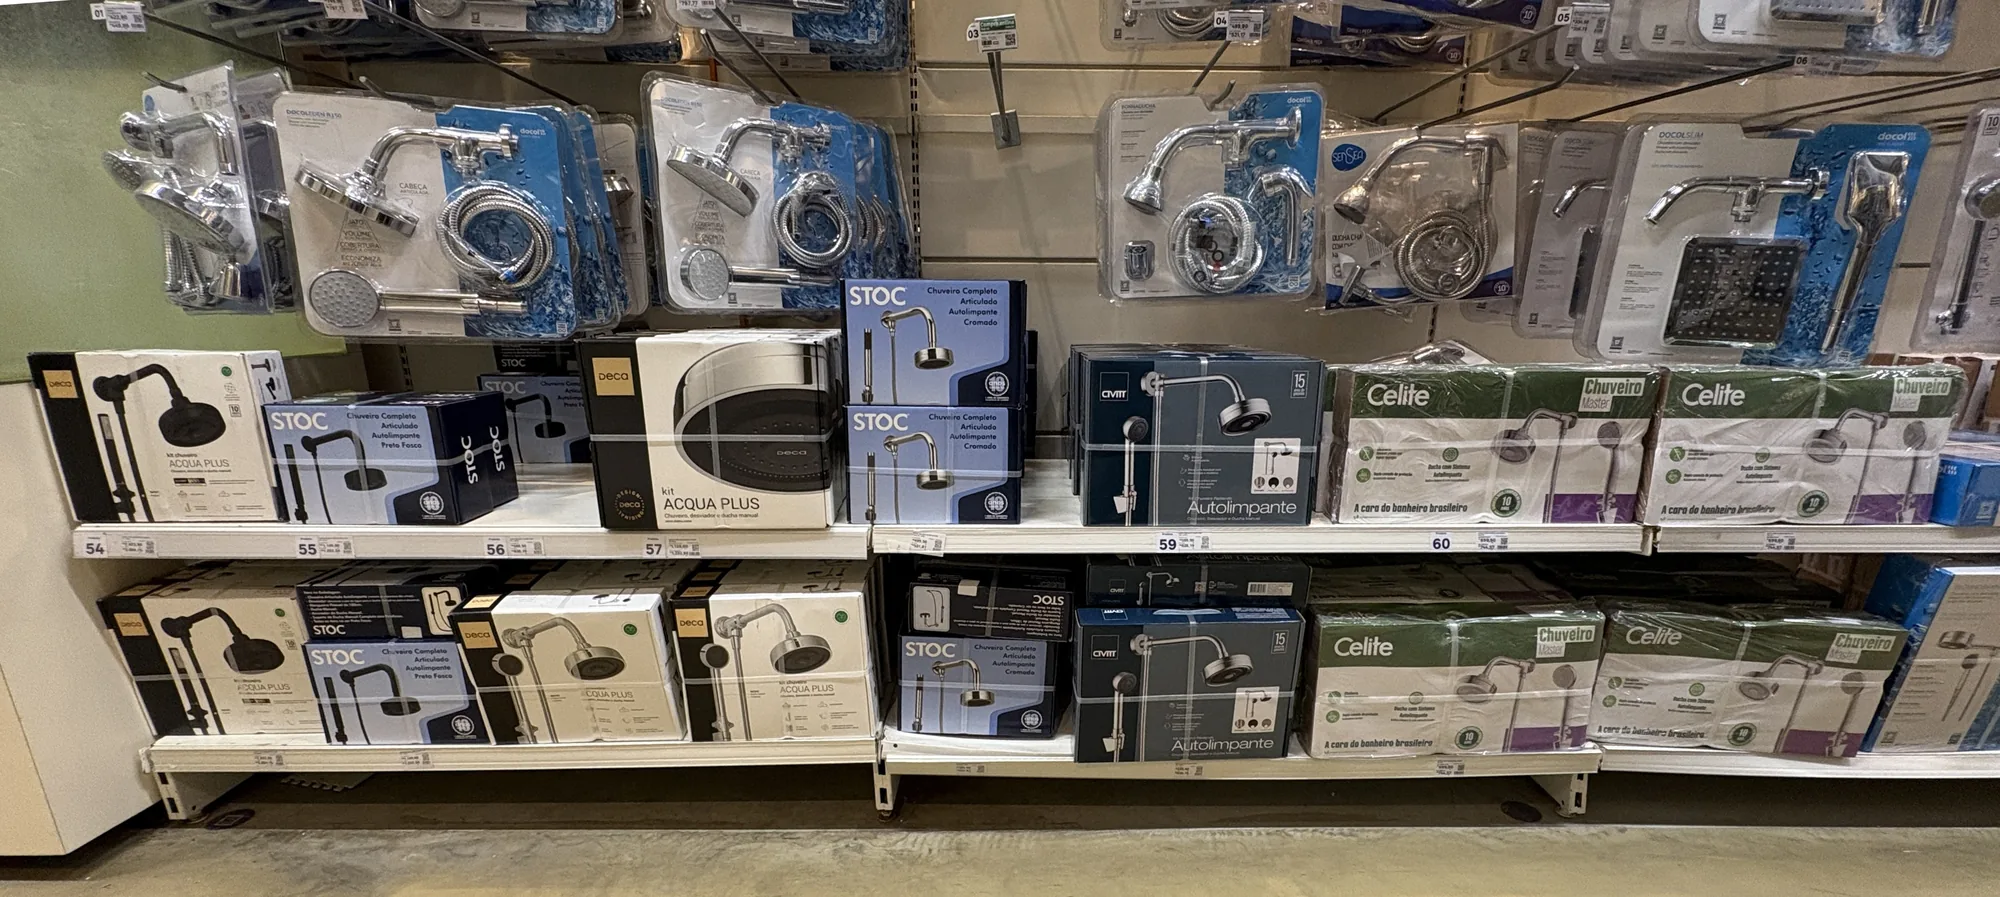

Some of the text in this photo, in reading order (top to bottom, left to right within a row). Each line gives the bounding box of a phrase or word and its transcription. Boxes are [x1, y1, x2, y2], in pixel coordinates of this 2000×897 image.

[94, 9, 104, 18] 01
[1557, 13, 1570, 22] 05
[1216, 17, 1227, 25] 04
[968, 29, 979, 39] 03
[1796, 56, 1808, 65] 06
[1287, 96, 1306, 104] docol
[1987, 116, 1999, 127] 10
[520, 128, 540, 136] docol
[1877, 132, 1908, 141] docol
[849, 286, 906, 306] STOC
[927, 287, 998, 296] Chuveiro Completo
[949, 308, 998, 316] Autolimpante
[501, 358, 526, 368] STOC
[598, 371, 629, 381] Deca
[1294, 374, 1306, 388] 15
[484, 381, 526, 394] STOC
[1584, 378, 1643, 395] Chuveiro
[1895, 378, 1950, 394] Chuveiro
[1367, 383, 1430, 407] Celite
[1682, 383, 1746, 407] Celite
[1581, 397, 1610, 409] Master
[271, 411, 328, 431] STOC
[346, 412, 417, 421] Chuveiro Completo
[853, 412, 909, 431] STOC
[928, 413, 997, 422] Chuveiro Completo
[371, 432, 421, 440] Autolimpante
[950, 433, 997, 441] Autolimpante
[381, 441, 422, 449] Preto Fosco
[489, 425, 506, 473] STOC
[169, 459, 230, 469] ACQUA PLUS
[460, 435, 479, 485] STOC
[661, 487, 674, 496] kit
[663, 497, 760, 511] ACQUA PLUS
[1502, 497, 1512, 506] 10
[1809, 497, 1820, 507] 10
[1186, 500, 1297, 516] Autolimpante
[1354, 504, 1360, 512] A
[1381, 504, 1391, 512] do
[1392, 503, 1428, 512] banheiro
[1429, 503, 1468, 512] brasileiro
[1661, 505, 1775, 514] A cara do banheiro brasileiro
[1159, 538, 1176, 550] 59
[1432, 538, 1450, 549] 60
[85, 543, 104, 555] 54
[298, 543, 317, 555] 55
[486, 543, 505, 556] 56
[645, 543, 663, 556] 57
[1032, 594, 1065, 605] STOC
[680, 619, 704, 627] Deca
[313, 624, 346, 635] STOC
[1539, 627, 1593, 642] Chuveiro
[465, 631, 491, 639] Deca
[1275, 632, 1286, 645] 15
[1625, 626, 1683, 646] Celite
[1333, 636, 1394, 657] Celite
[1835, 634, 1892, 650] Chuveiro
[905, 641, 956, 658] STOC
[1005, 645, 1036, 653] Completo
[311, 649, 365, 665] STOC
[992, 660, 1036, 668] Autolimpante
[780, 684, 834, 694] ACQUA PLUS
[611, 691, 634, 699] PLUS
[1465, 732, 1474, 741] 10
[1171, 737, 1275, 752] Autolimpante
[1325, 738, 1433, 748] A cara do banheiro brasileiro
